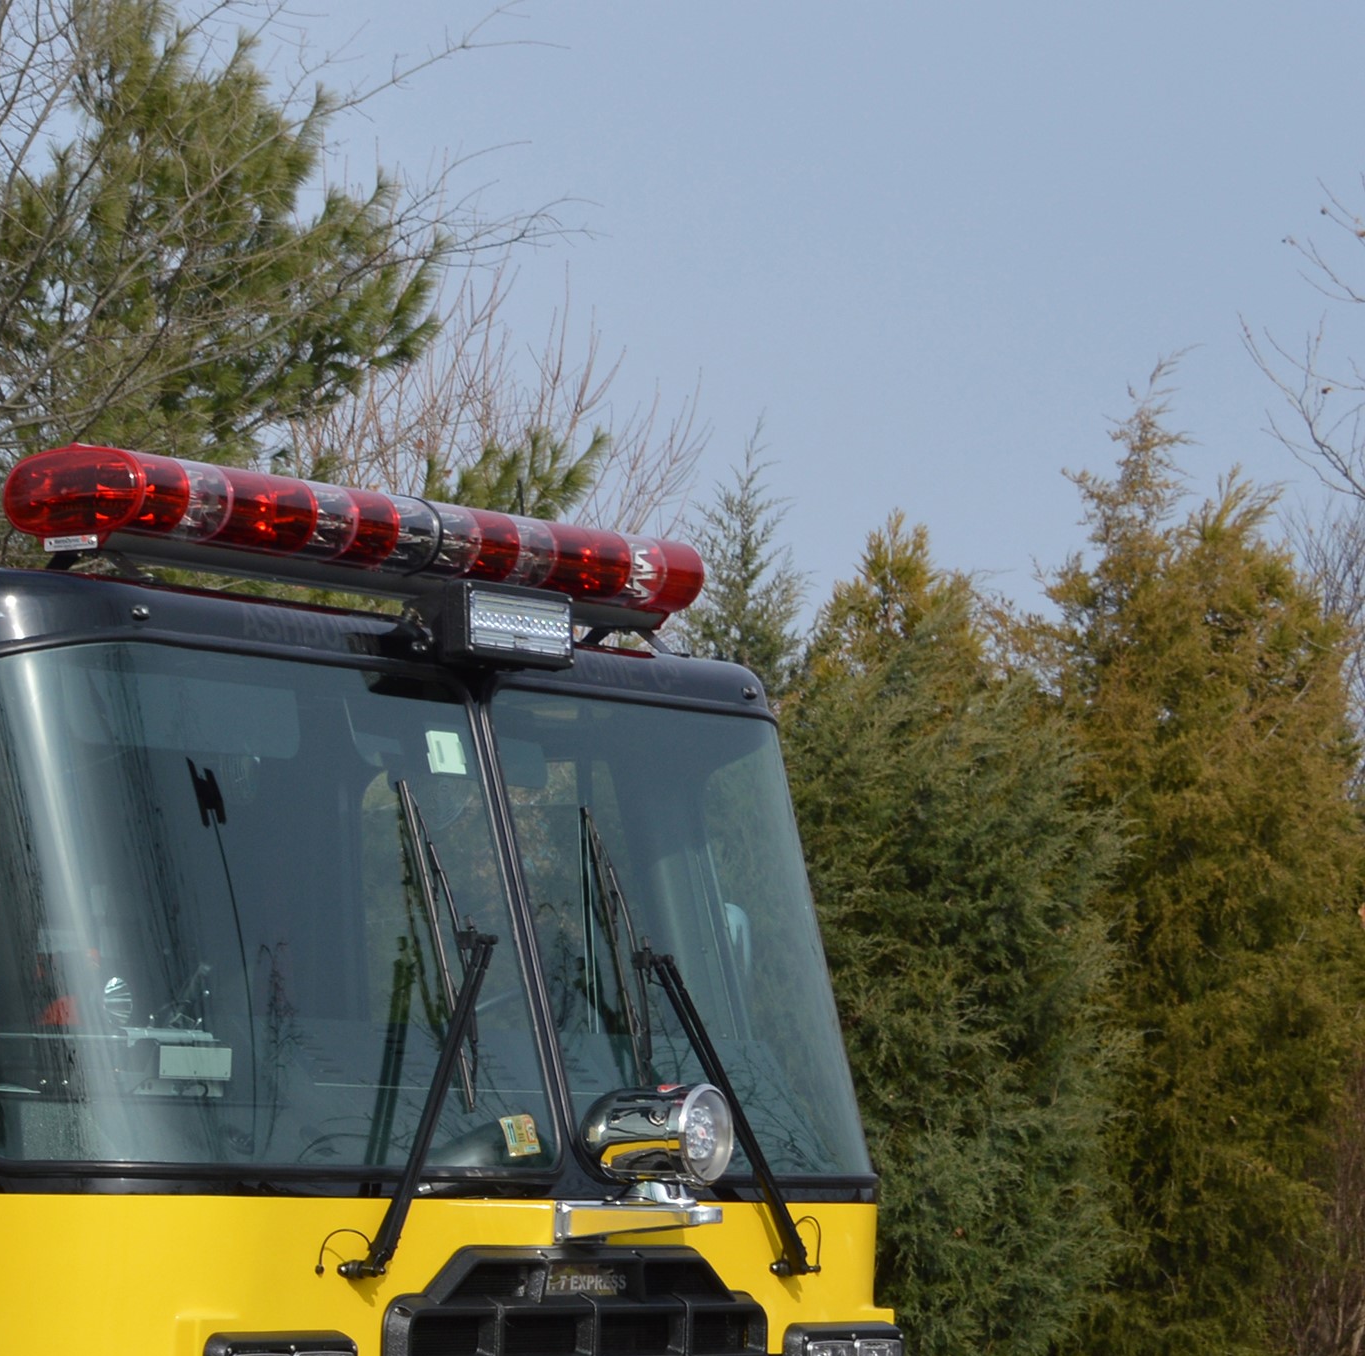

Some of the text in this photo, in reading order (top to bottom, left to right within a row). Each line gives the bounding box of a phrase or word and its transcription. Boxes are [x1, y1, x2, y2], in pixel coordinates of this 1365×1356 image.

[242, 606, 381, 655] ASHBURN
[572, 650, 644, 687] NGINE
[570, 1274, 627, 1290] EXPRESS
